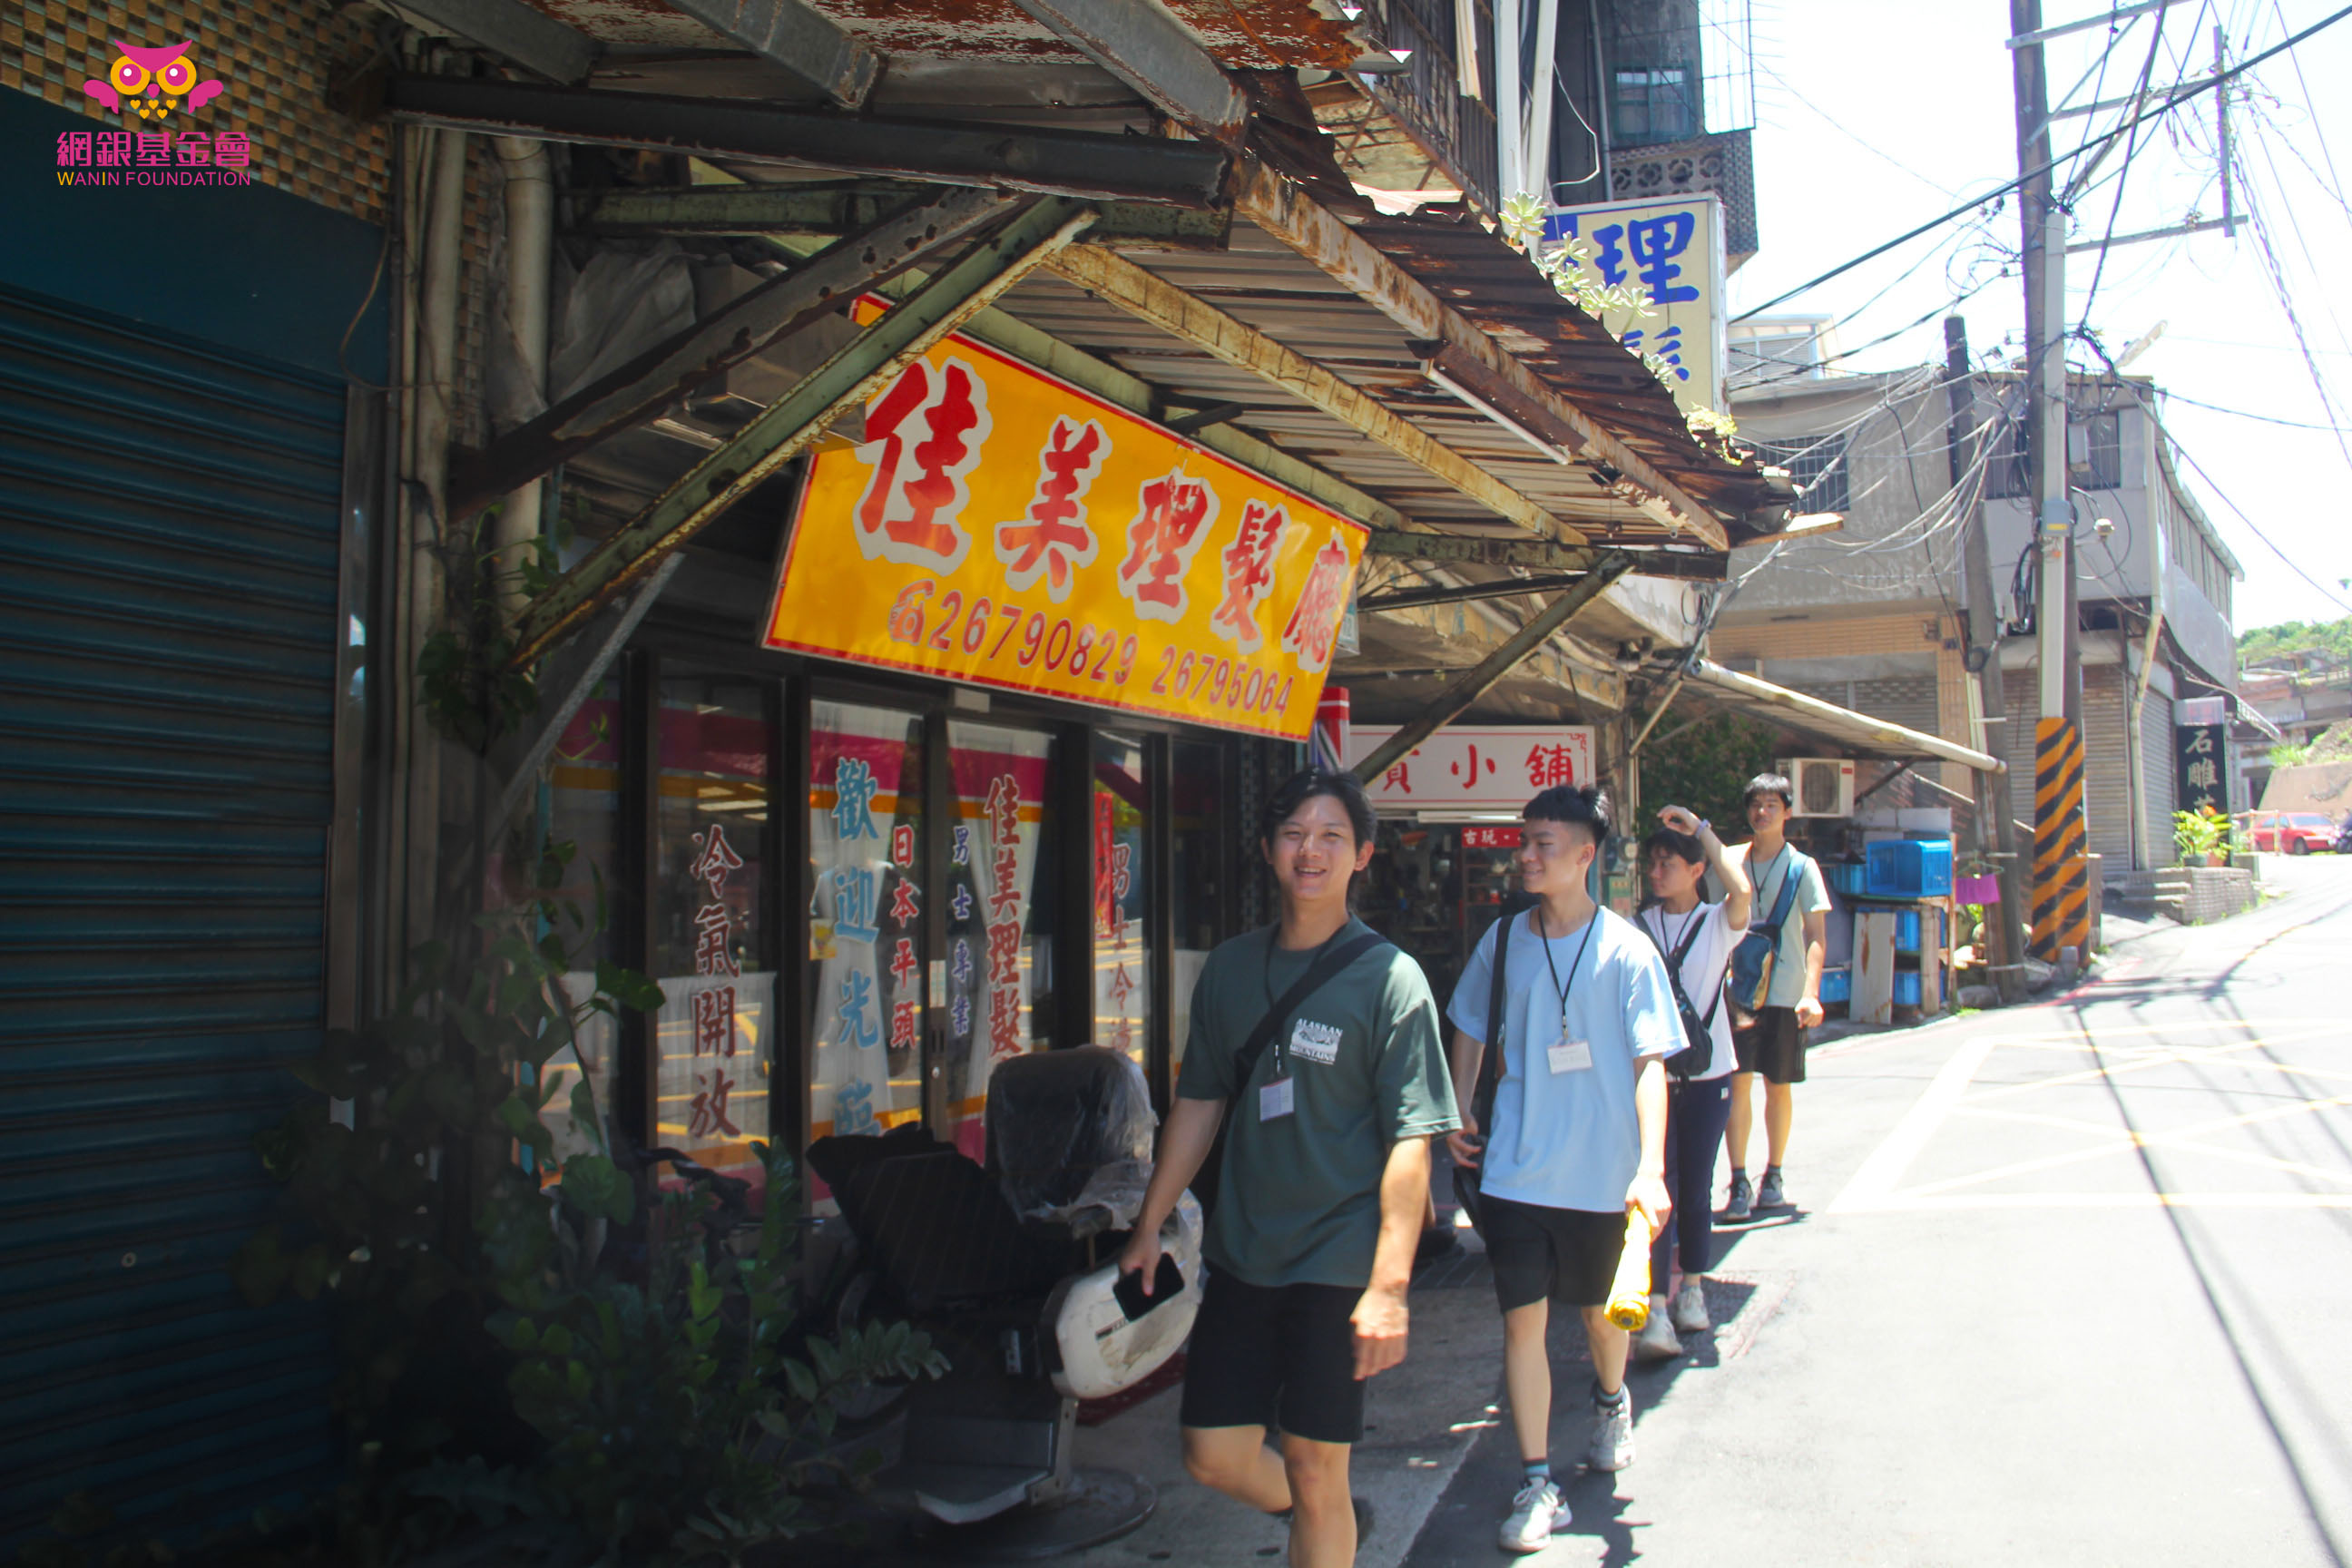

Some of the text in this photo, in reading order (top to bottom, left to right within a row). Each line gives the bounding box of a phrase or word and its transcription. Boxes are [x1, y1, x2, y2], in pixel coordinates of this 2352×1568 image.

[858, 358, 1349, 670] 佳美理髮廳
[927, 590, 1294, 718] 26790829 26795064
[690, 824, 743, 1140] 冷氣開放
[831, 757, 882, 1136] 歡迎光臨
[890, 824, 918, 1049] 日本平頭
[952, 826, 972, 1037] 男士專業
[984, 774, 1023, 1060] 佳美理髮
